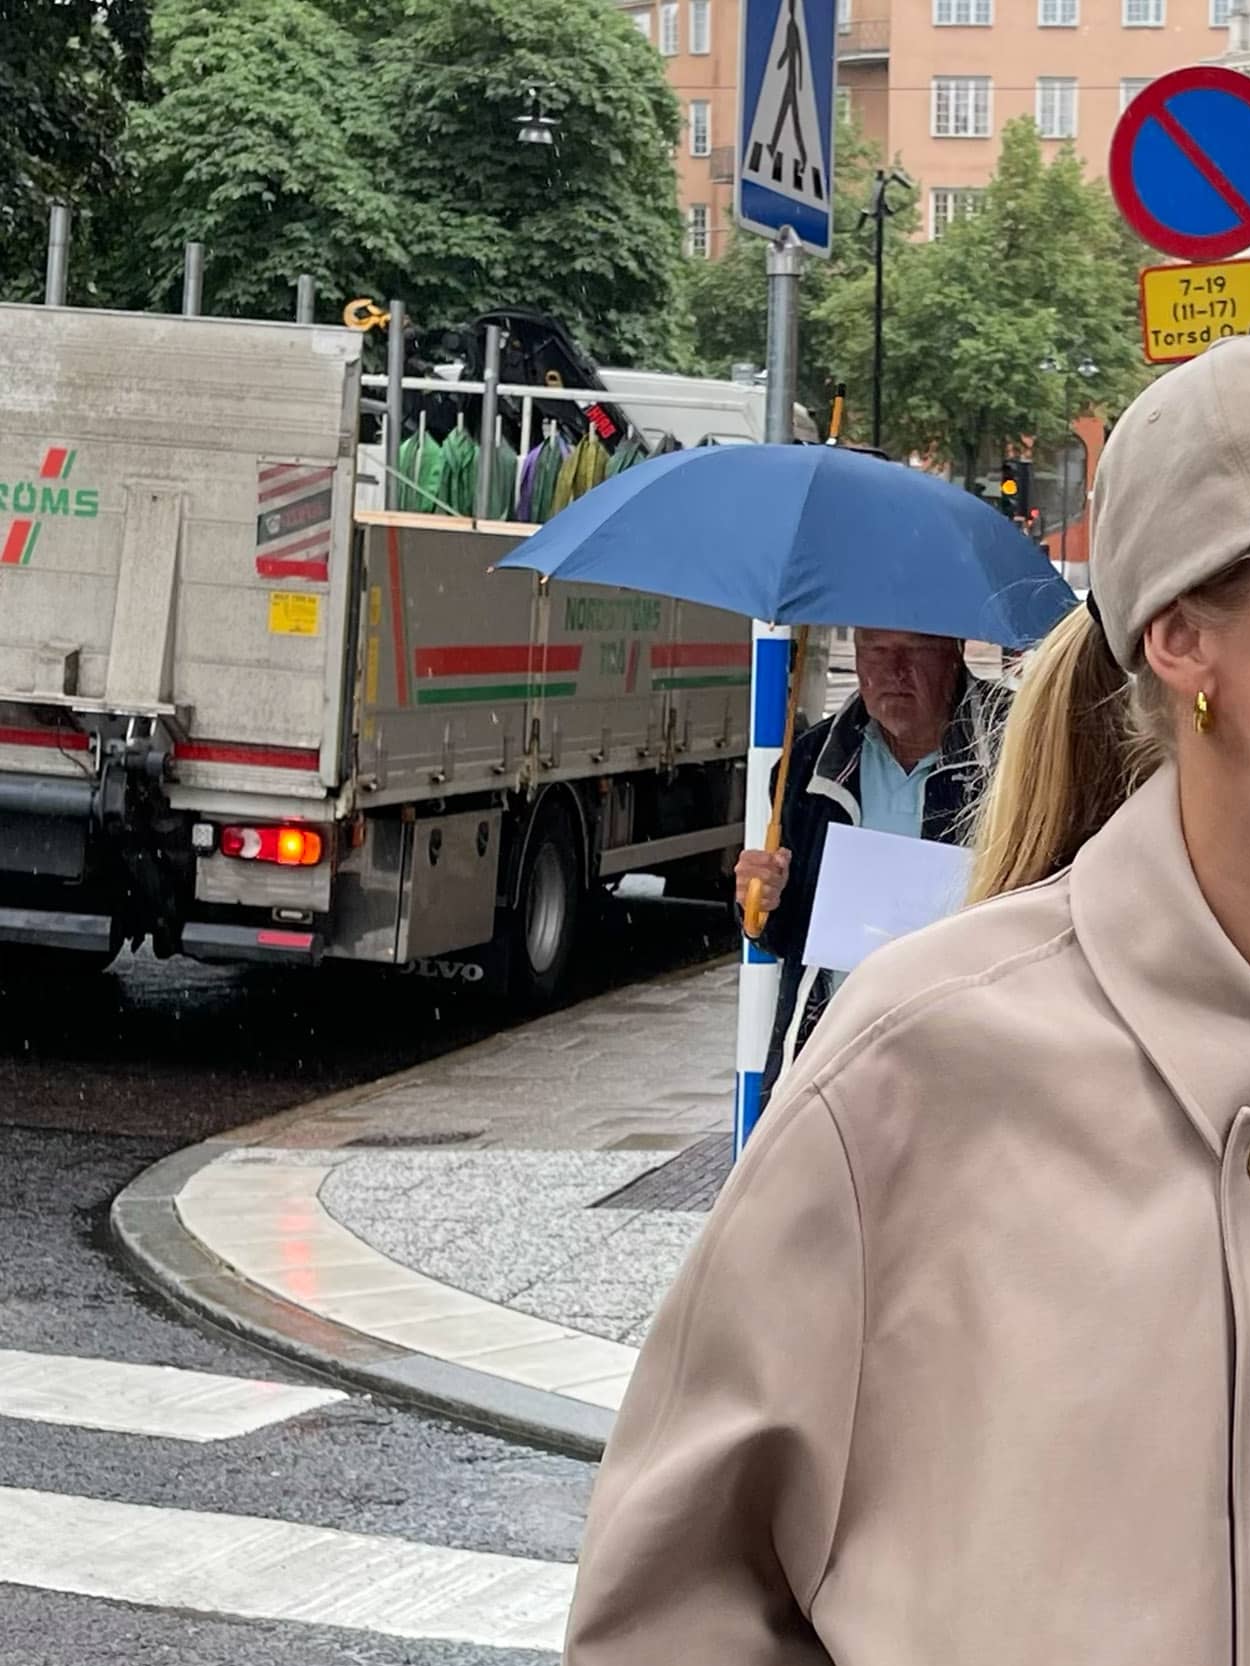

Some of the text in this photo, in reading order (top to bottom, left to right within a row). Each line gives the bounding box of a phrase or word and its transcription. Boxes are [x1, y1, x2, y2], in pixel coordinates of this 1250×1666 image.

[1179, 276, 1226, 296] 7-19
[1172, 298, 1236, 322] (11-17)
[1151, 326, 1211, 347] Torsd
